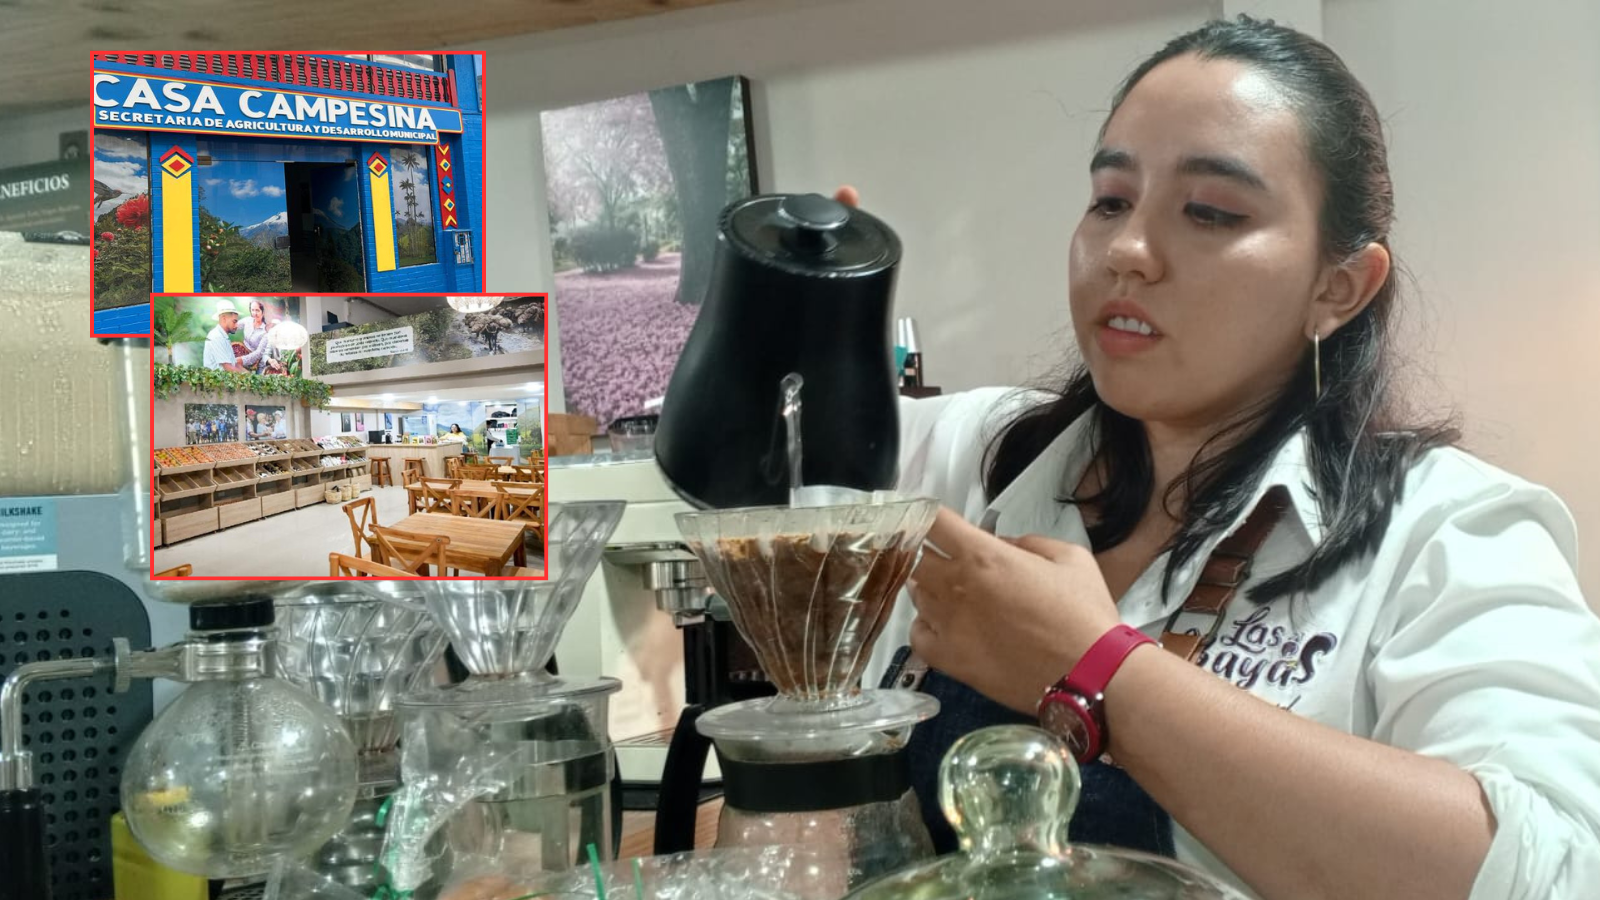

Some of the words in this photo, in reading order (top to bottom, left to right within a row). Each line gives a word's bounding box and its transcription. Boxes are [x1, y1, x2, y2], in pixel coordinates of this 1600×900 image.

[94, 73, 226, 116] CASA
[238, 90, 437, 131] CAMPESINA
[98, 110, 202, 127] SECRETARIA
[204, 118, 224, 128] DE
[225, 119, 311, 133] AGRICULTURA
[311, 125, 321, 134] Y
[321, 125, 390, 138] DESARROLLO
[390, 130, 437, 141] MUNICIPAL
[0, 173, 70, 199] NEFICIOS
[1220, 606, 1285, 654] Las
[1194, 631, 1338, 690] ayas
